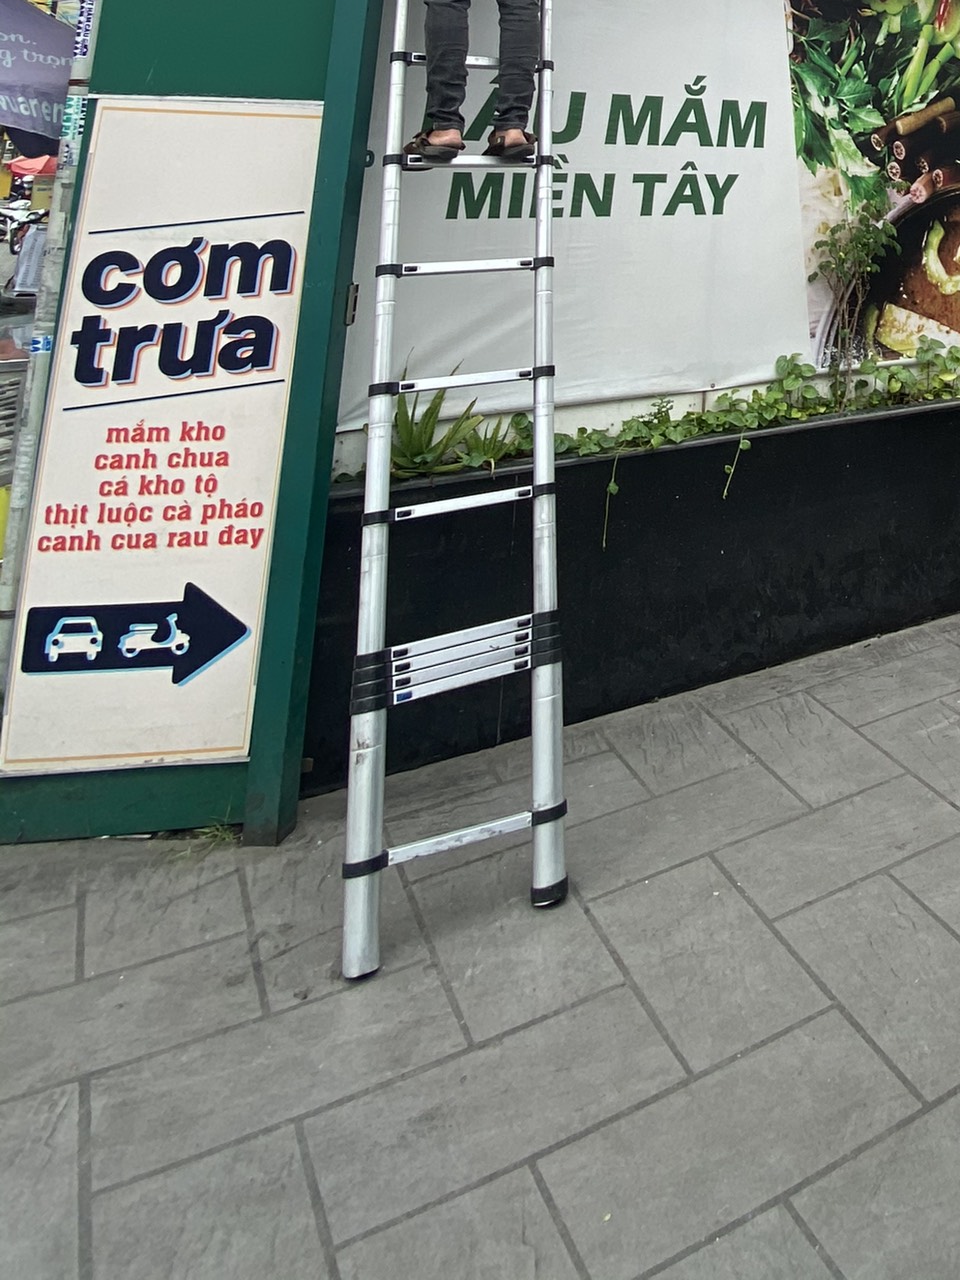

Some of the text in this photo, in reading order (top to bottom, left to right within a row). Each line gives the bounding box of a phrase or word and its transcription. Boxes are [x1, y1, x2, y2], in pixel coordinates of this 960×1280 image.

[604, 75, 768, 148] MẮM
[632, 161, 739, 216] TÂY
[81, 236, 297, 310] cơm
[70, 309, 280, 388] trưa
[105, 419, 226, 444] mắm kho
[94, 447, 230, 471] canh chua
[99, 473, 219, 498] cá kho tộ
[44, 497, 264, 529] thịt luộc cà pháo
[37, 524, 264, 552] canh cua rau đay
